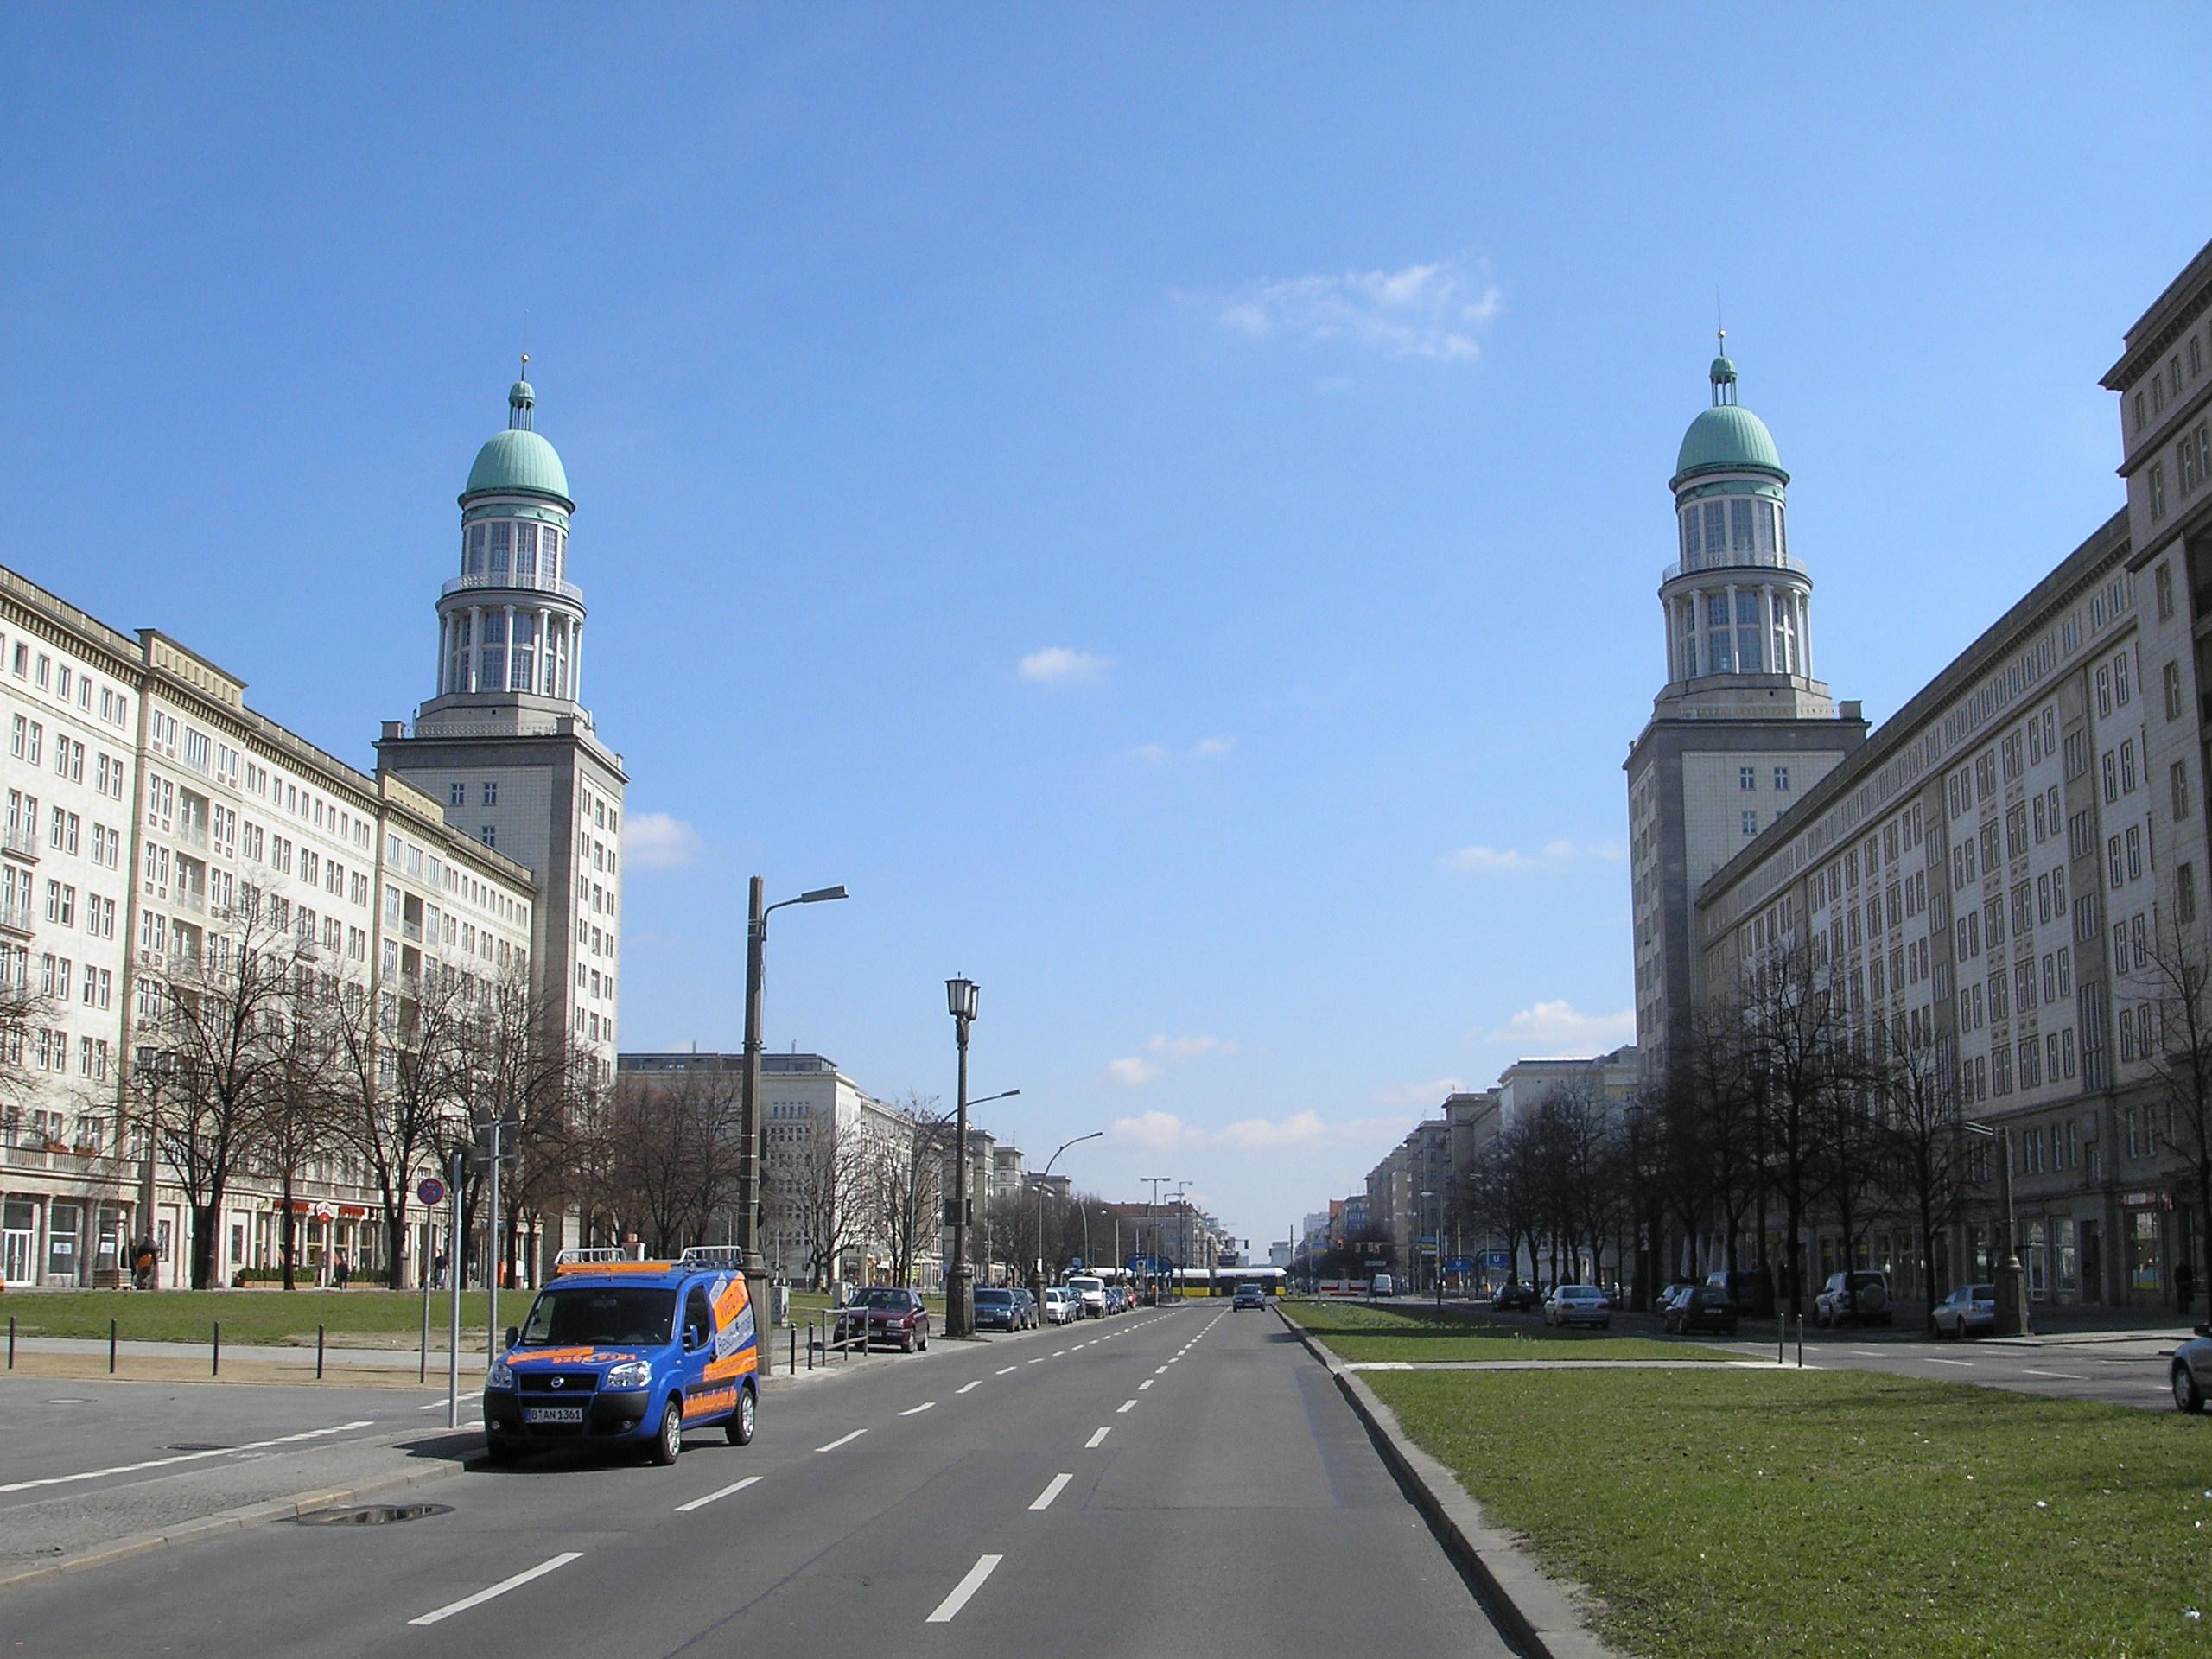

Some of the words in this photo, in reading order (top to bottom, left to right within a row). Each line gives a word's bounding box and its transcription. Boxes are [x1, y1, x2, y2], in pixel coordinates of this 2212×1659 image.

[1493, 1255, 1500, 1263] U
[531, 1409, 538, 1420] B
[543, 1409, 556, 1420] AN
[557, 1409, 582, 1420] 1361
